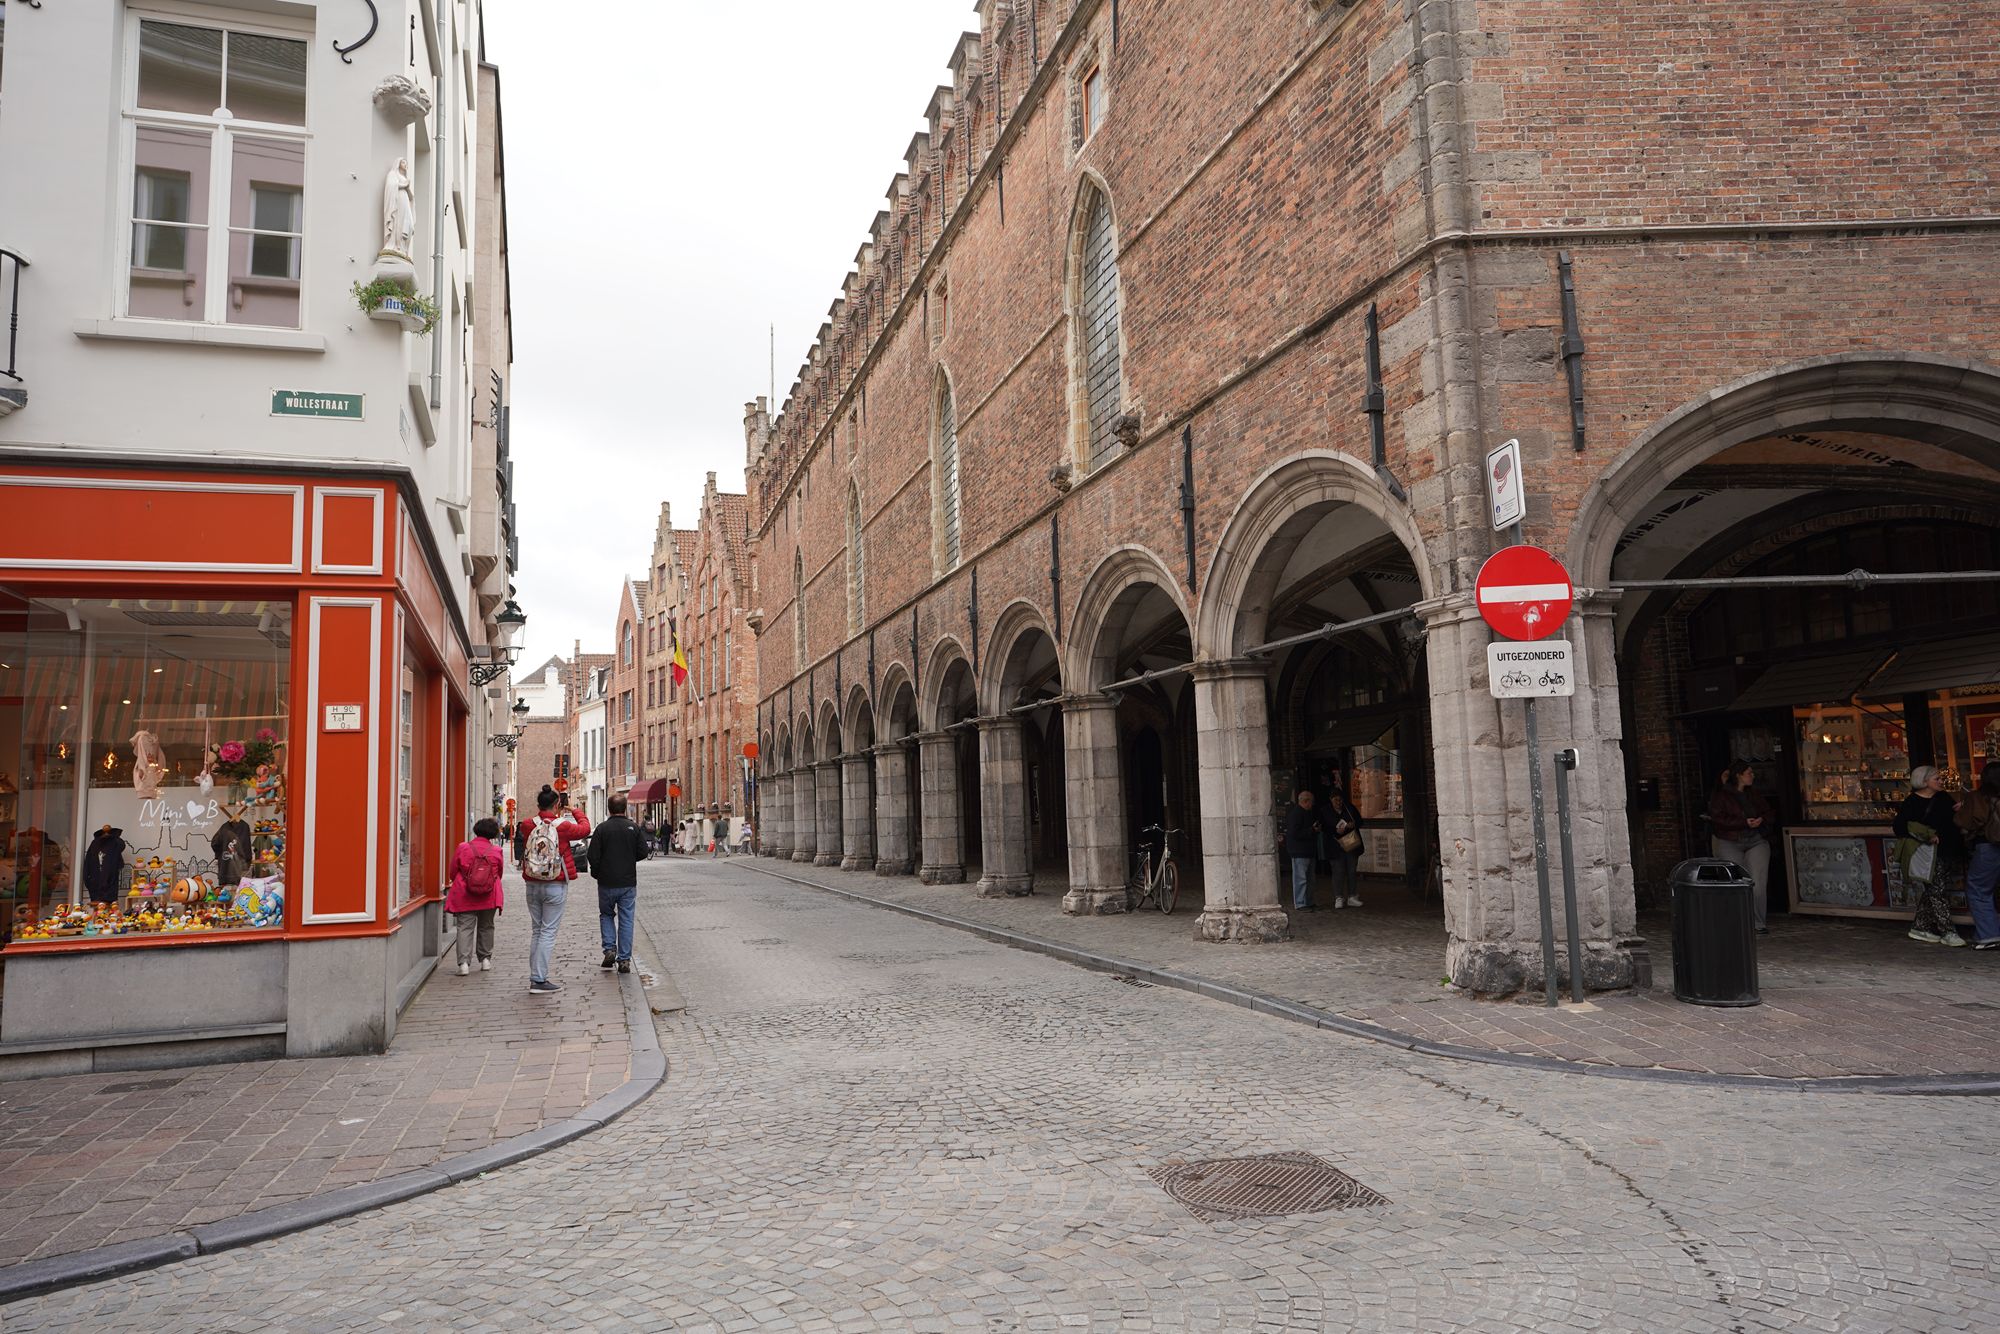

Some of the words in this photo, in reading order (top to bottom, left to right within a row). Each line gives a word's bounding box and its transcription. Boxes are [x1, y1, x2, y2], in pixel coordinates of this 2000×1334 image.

[285, 397, 349, 410] WOLLESTRAAT
[1496, 651, 1565, 661] UITGEZONDERD
[139, 799, 184, 821] Mini
[206, 799, 219, 819] B
